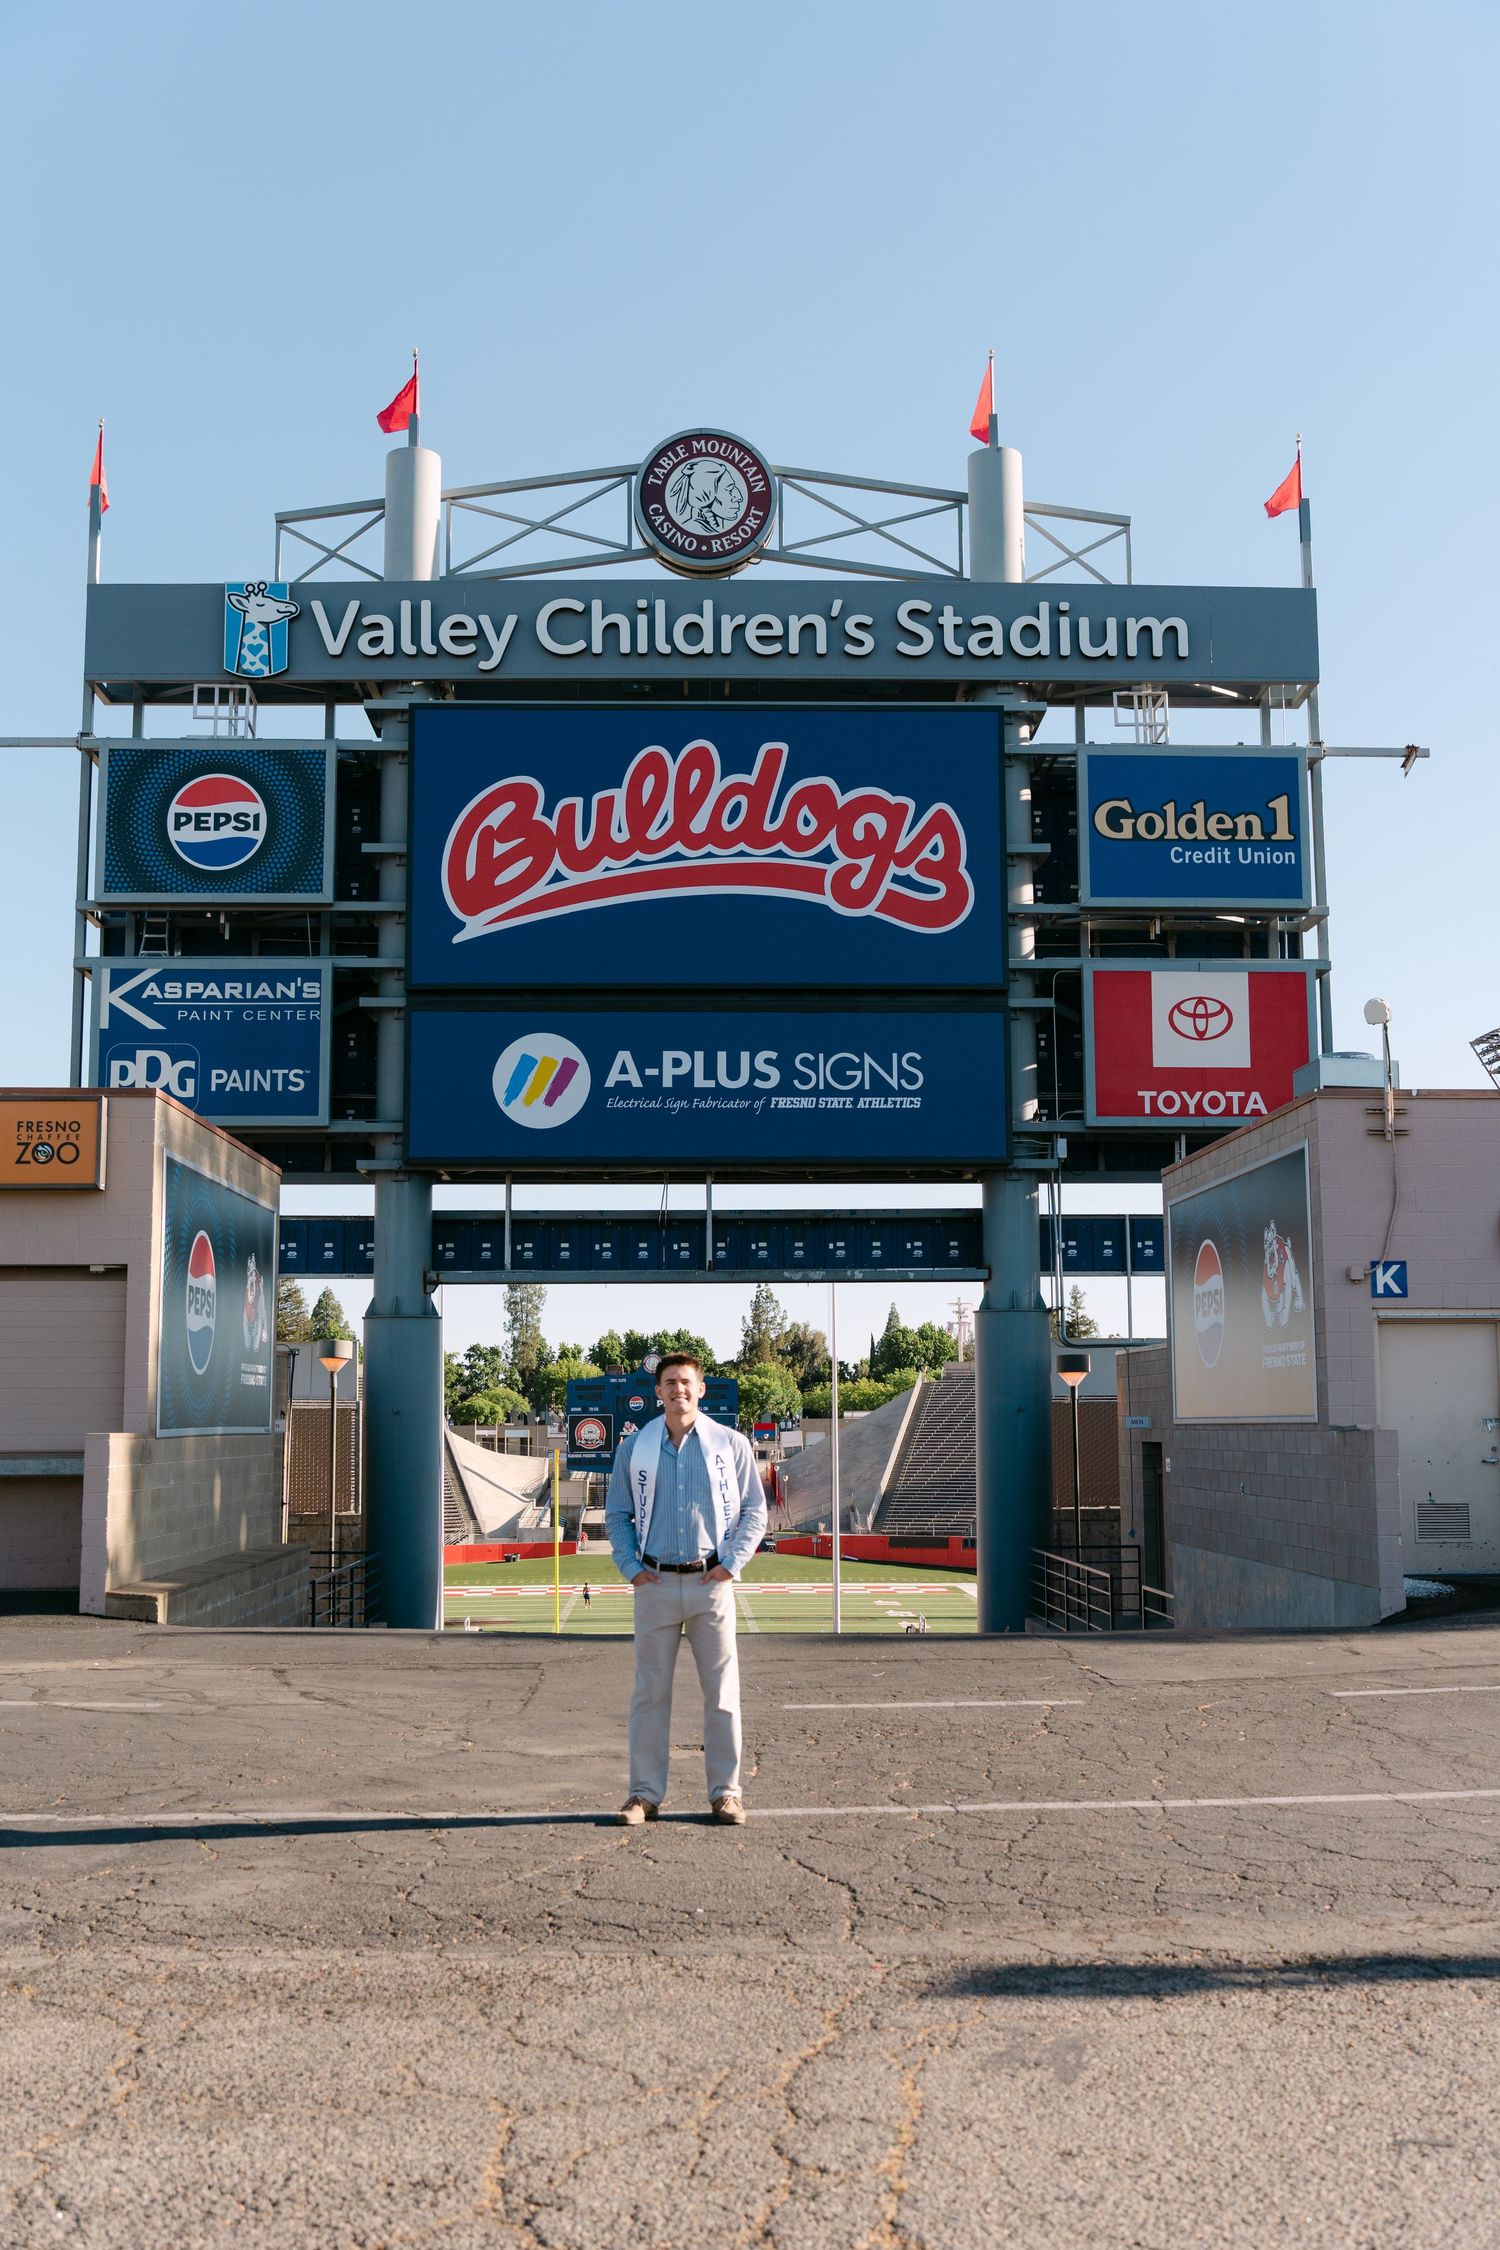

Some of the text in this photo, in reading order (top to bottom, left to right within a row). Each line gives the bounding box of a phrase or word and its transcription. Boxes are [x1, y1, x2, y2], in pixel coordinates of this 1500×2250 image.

[648, 440, 766, 493] TABLE MOUNTAIN
[649, 504, 764, 553] CASINO RESORT
[311, 598, 1189, 671] Valley Children's Stadium
[174, 812, 260, 832] PEPSI
[441, 739, 974, 944] Bulldogs
[1170, 846, 1296, 865] Credit Union
[100, 968, 321, 1029] KASPARIAN'S
[178, 1010, 321, 1021] PAINT CENTER
[110, 1050, 196, 1098] PPG
[604, 1050, 924, 1091] A-PLUS SIGNS
[606, 1097, 922, 1114] Electrical Sign Fabricator of FRESNO STATE ATHLETICS
[1137, 1090, 1269, 1115] TOYOTA
[16, 1133, 80, 1141] CHAFFEE
[17, 1120, 80, 1133] FRESNO
[14, 1141, 80, 1165] ZOO
[1376, 1264, 1403, 1294] K
[188, 1285, 214, 1319] PEPSI
[1196, 1288, 1223, 1320] PEPSI
[715, 1454, 733, 1541] ATHLETE
